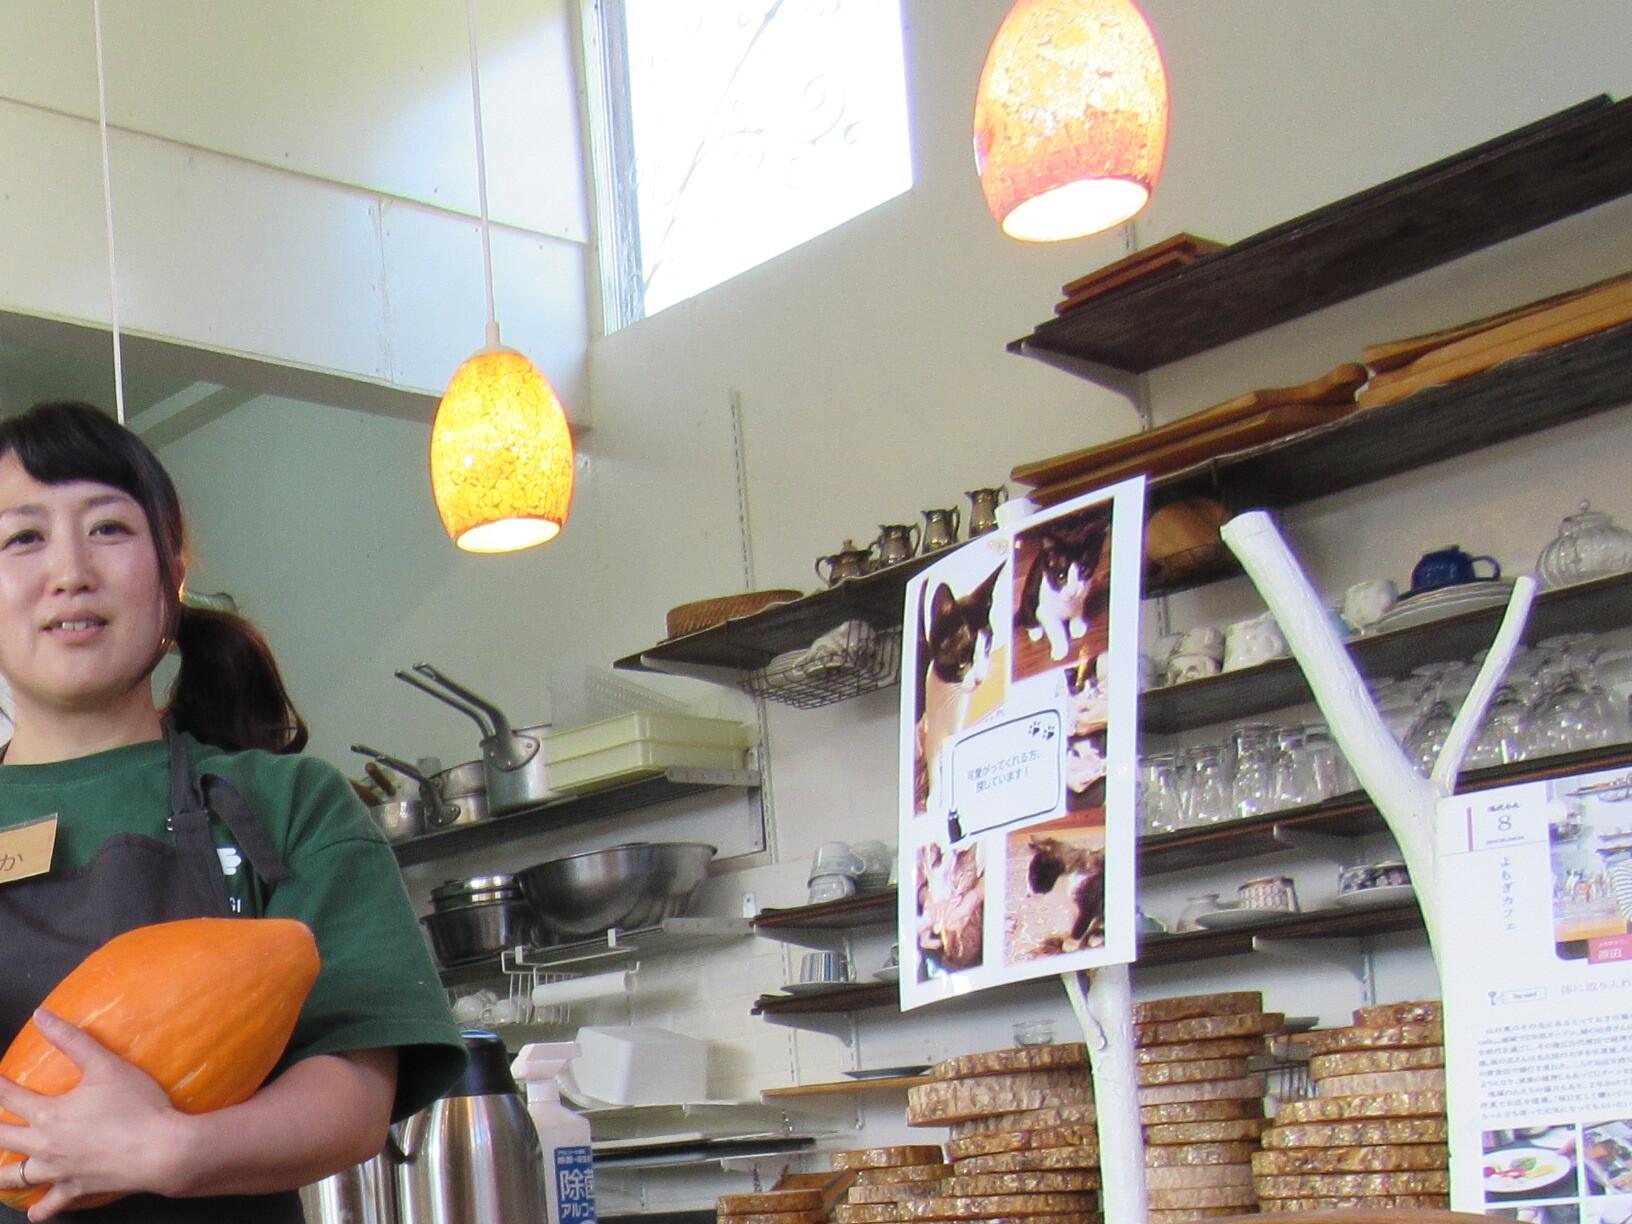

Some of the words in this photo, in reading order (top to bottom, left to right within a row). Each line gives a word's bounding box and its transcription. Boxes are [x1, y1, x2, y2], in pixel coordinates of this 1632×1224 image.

[1498, 815, 1512, 831] 8
[1501, 857, 1516, 930] よもぎカフェ
